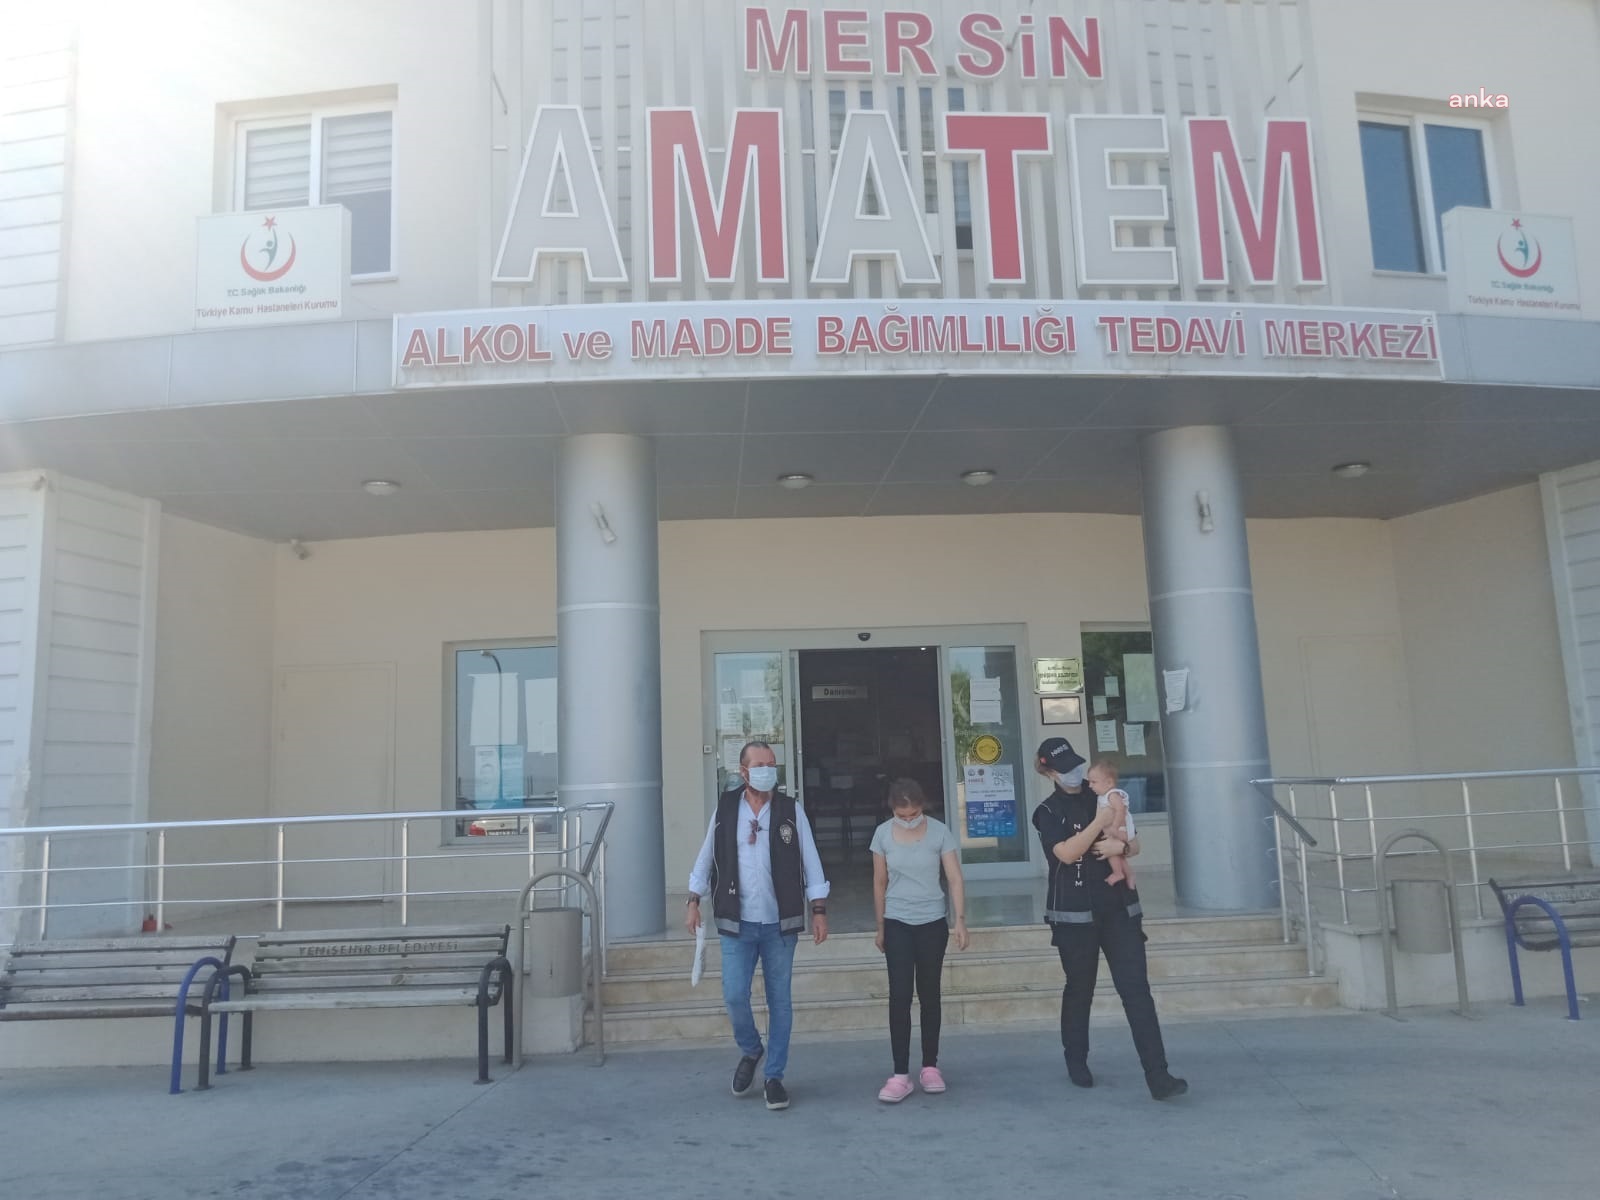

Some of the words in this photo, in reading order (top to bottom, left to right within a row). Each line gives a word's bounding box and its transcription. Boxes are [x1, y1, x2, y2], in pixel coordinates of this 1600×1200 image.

[492, 104, 1327, 287] AMATEM
[197, 307, 227, 319] Türkiye
[228, 305, 254, 316] Kamu
[256, 301, 303, 314] Hastaneleri
[304, 299, 338, 311] Kurumu
[401, 322, 553, 368] ALKOL
[562, 330, 613, 361] ve
[630, 316, 793, 360] MADDE
[816, 304, 1078, 355] BAĞIMLILIĞI
[1097, 311, 1248, 356] TEDAVİ
[1264, 316, 1439, 361] MERKEZİ
[299, 944, 372, 957] YENİŞEHİR
[378, 941, 458, 953] BELEDİYESİ
